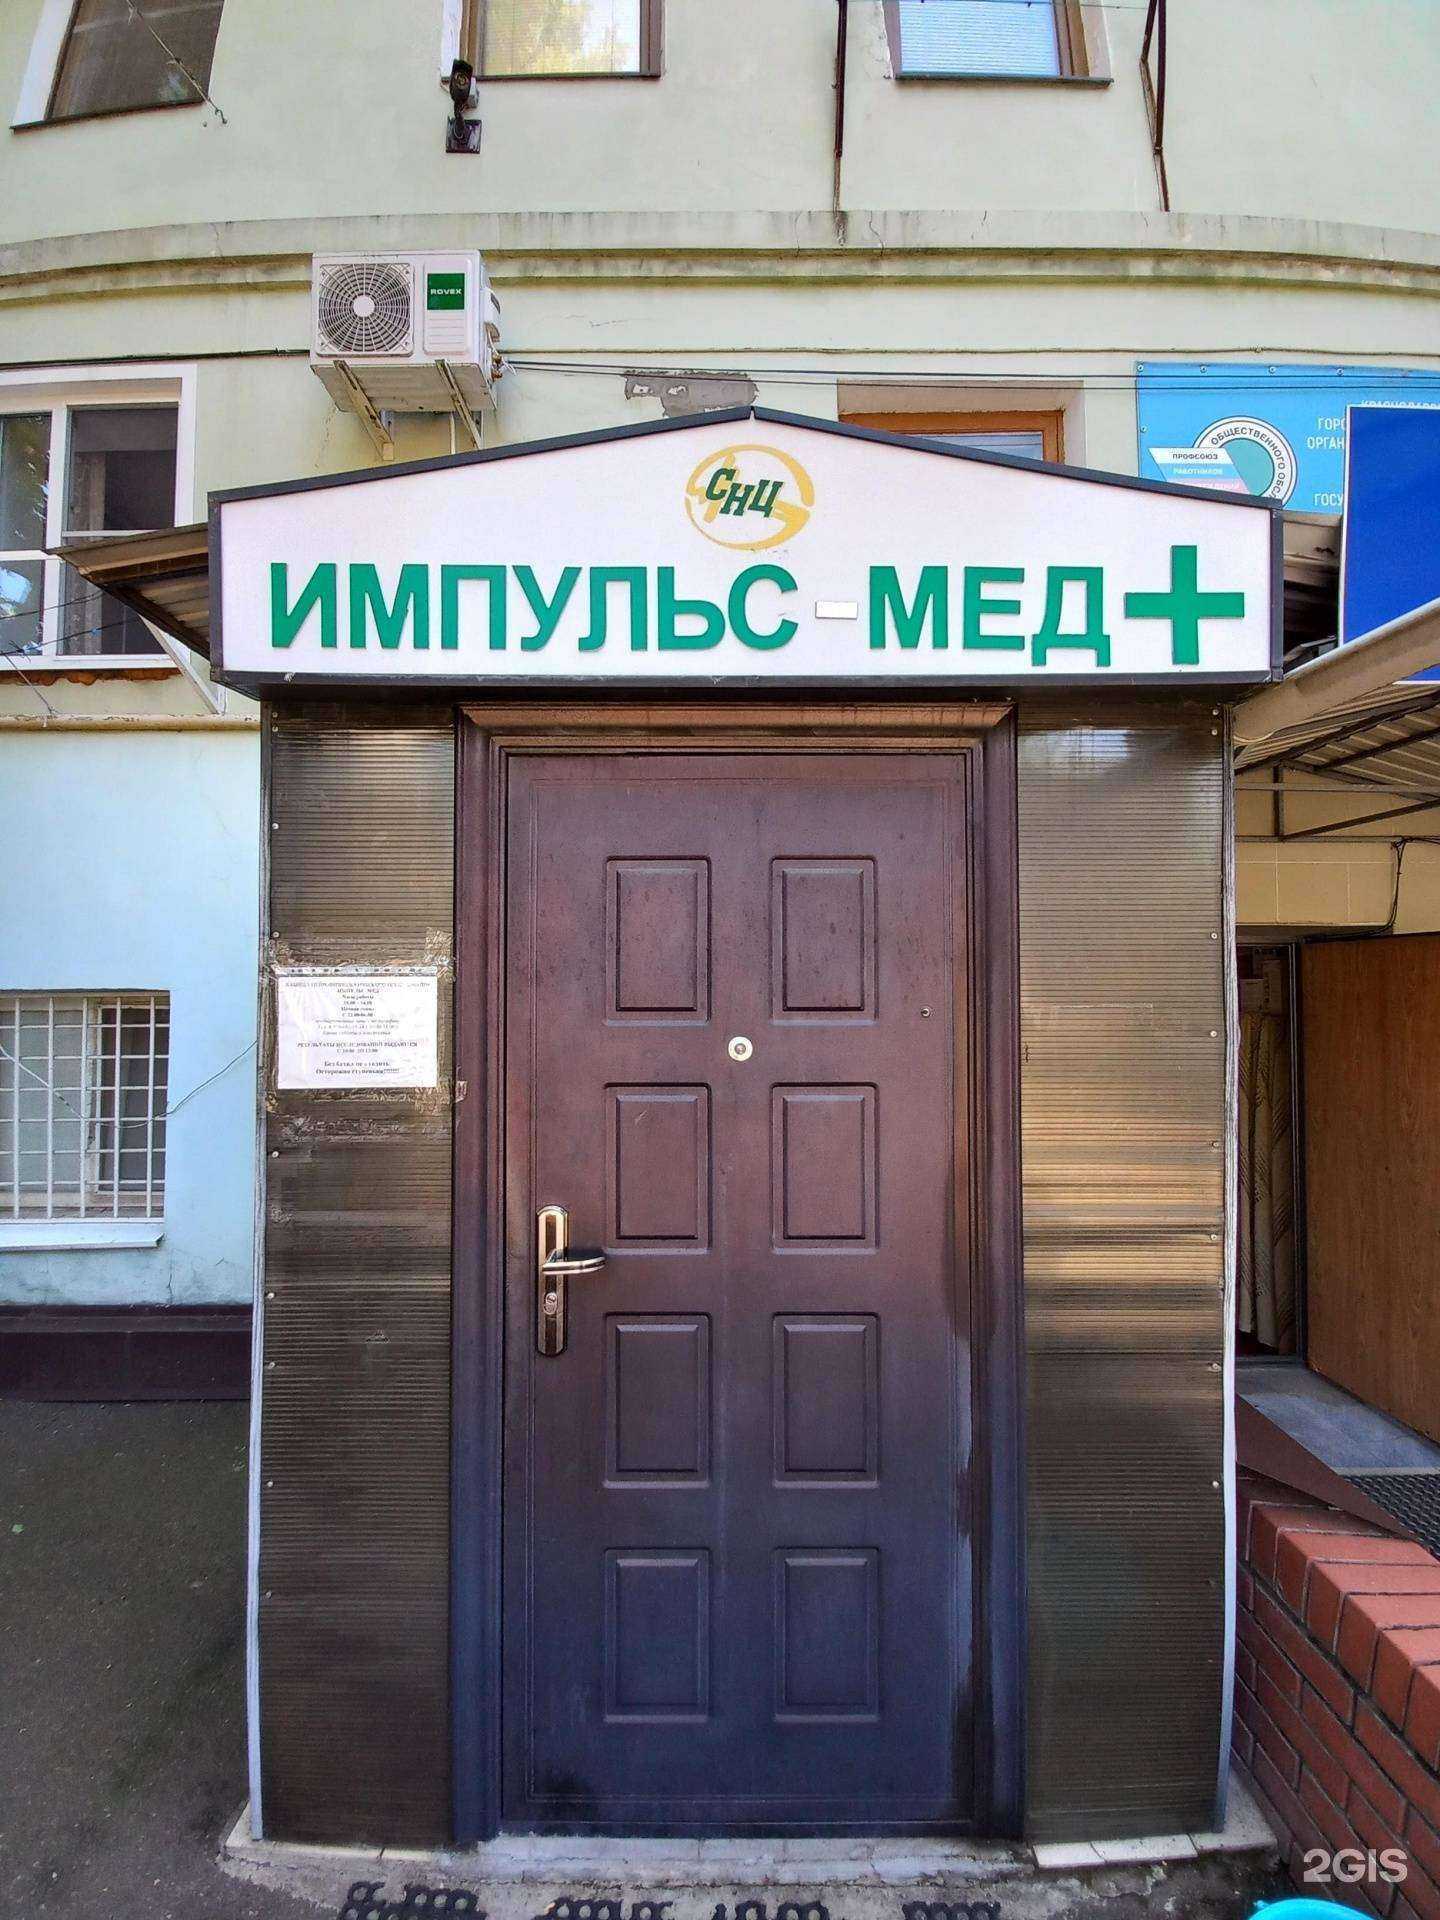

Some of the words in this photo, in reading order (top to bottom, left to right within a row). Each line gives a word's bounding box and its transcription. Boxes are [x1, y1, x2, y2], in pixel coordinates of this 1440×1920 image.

[430, 288, 463, 296] ROVEX
[1211, 427, 1286, 470] ОБЩЕСТВЕННОГО
[705, 468, 784, 518] СНЦ
[270, 562, 798, 652] ИМПУЛЬС
